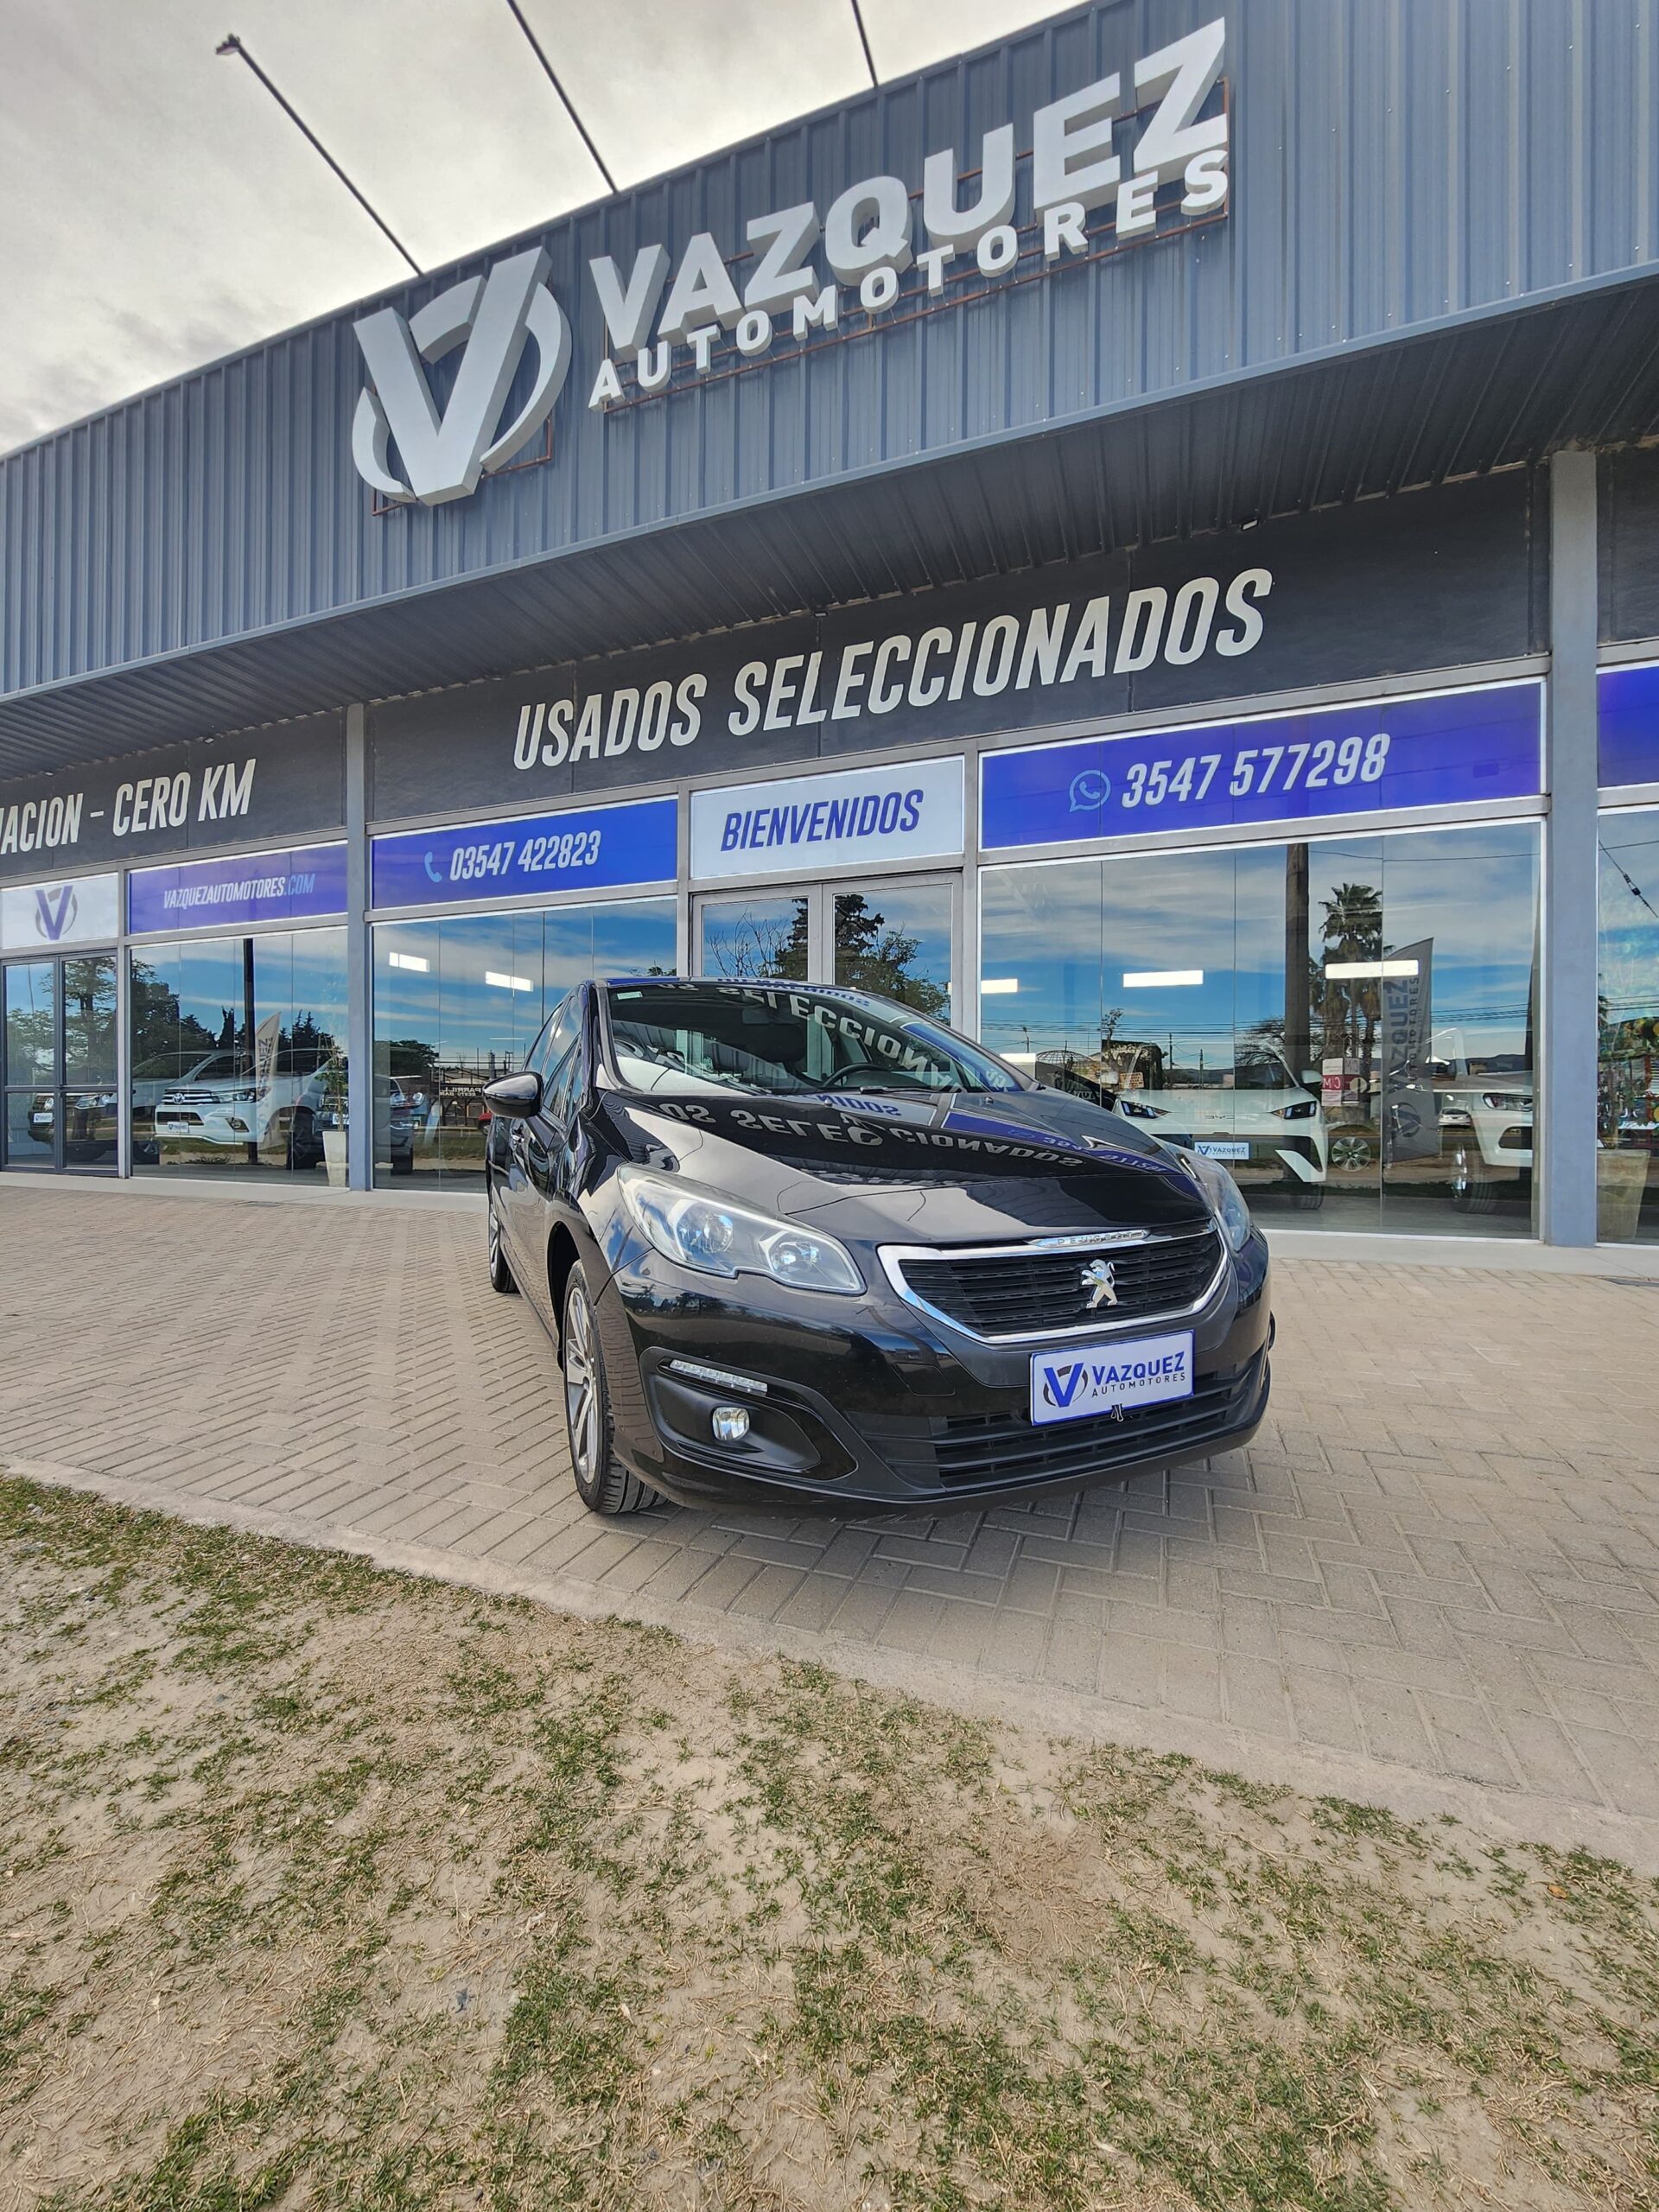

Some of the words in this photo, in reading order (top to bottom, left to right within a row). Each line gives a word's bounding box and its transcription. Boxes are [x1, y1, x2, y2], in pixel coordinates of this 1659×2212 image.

[589, 16, 1229, 358] VAZQUEZ
[588, 149, 1230, 412] AUTOMOTORES
[513, 673, 708, 770] USADOS
[728, 568, 1273, 736] SELECCIONADOS
[1121, 753, 1222, 808] 3547
[1230, 733, 1391, 797] 577298
[0, 792, 84, 855] ACION
[112, 772, 191, 837] CERO
[198, 759, 257, 822] KM
[721, 789, 924, 852] BIENVENIDOS
[449, 841, 516, 880] 03547
[518, 830, 601, 873] 422823
[163, 873, 316, 910] VAZQUEZAUTOMOTORES.COM
[1091, 1351, 1185, 1386] VAZQUEZ
[1091, 1372, 1185, 1398] AUTOMOTORES
